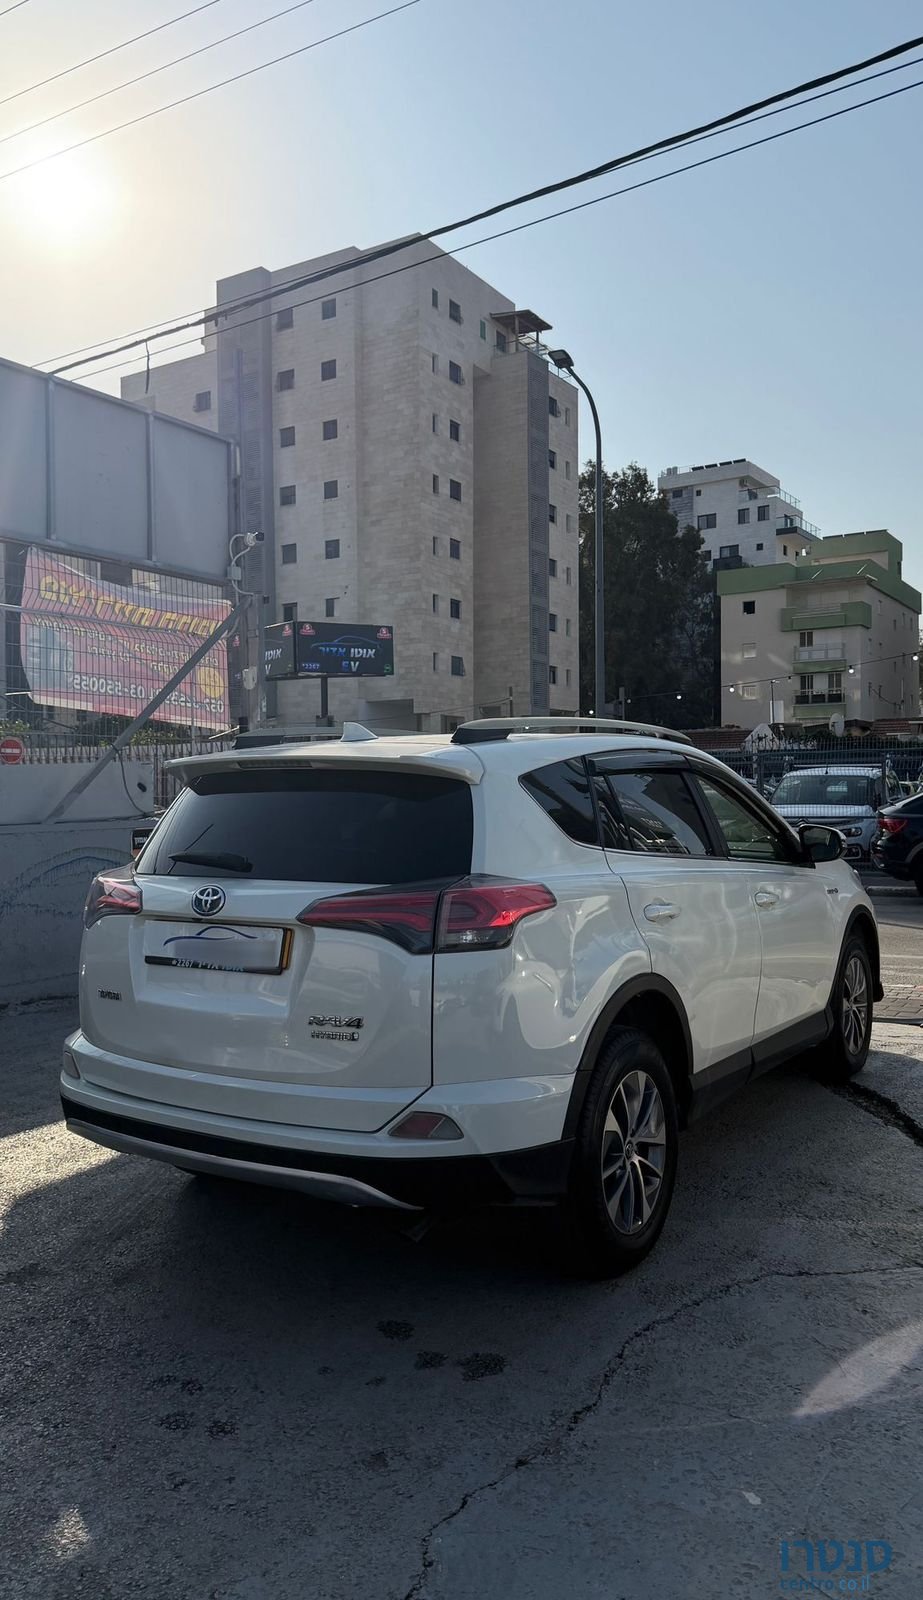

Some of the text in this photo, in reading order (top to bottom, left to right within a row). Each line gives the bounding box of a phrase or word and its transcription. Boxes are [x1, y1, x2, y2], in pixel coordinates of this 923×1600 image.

[350, 647, 376, 658] אוטו
[342, 660, 360, 673] EV
[308, 1014, 365, 1029] RAV4
